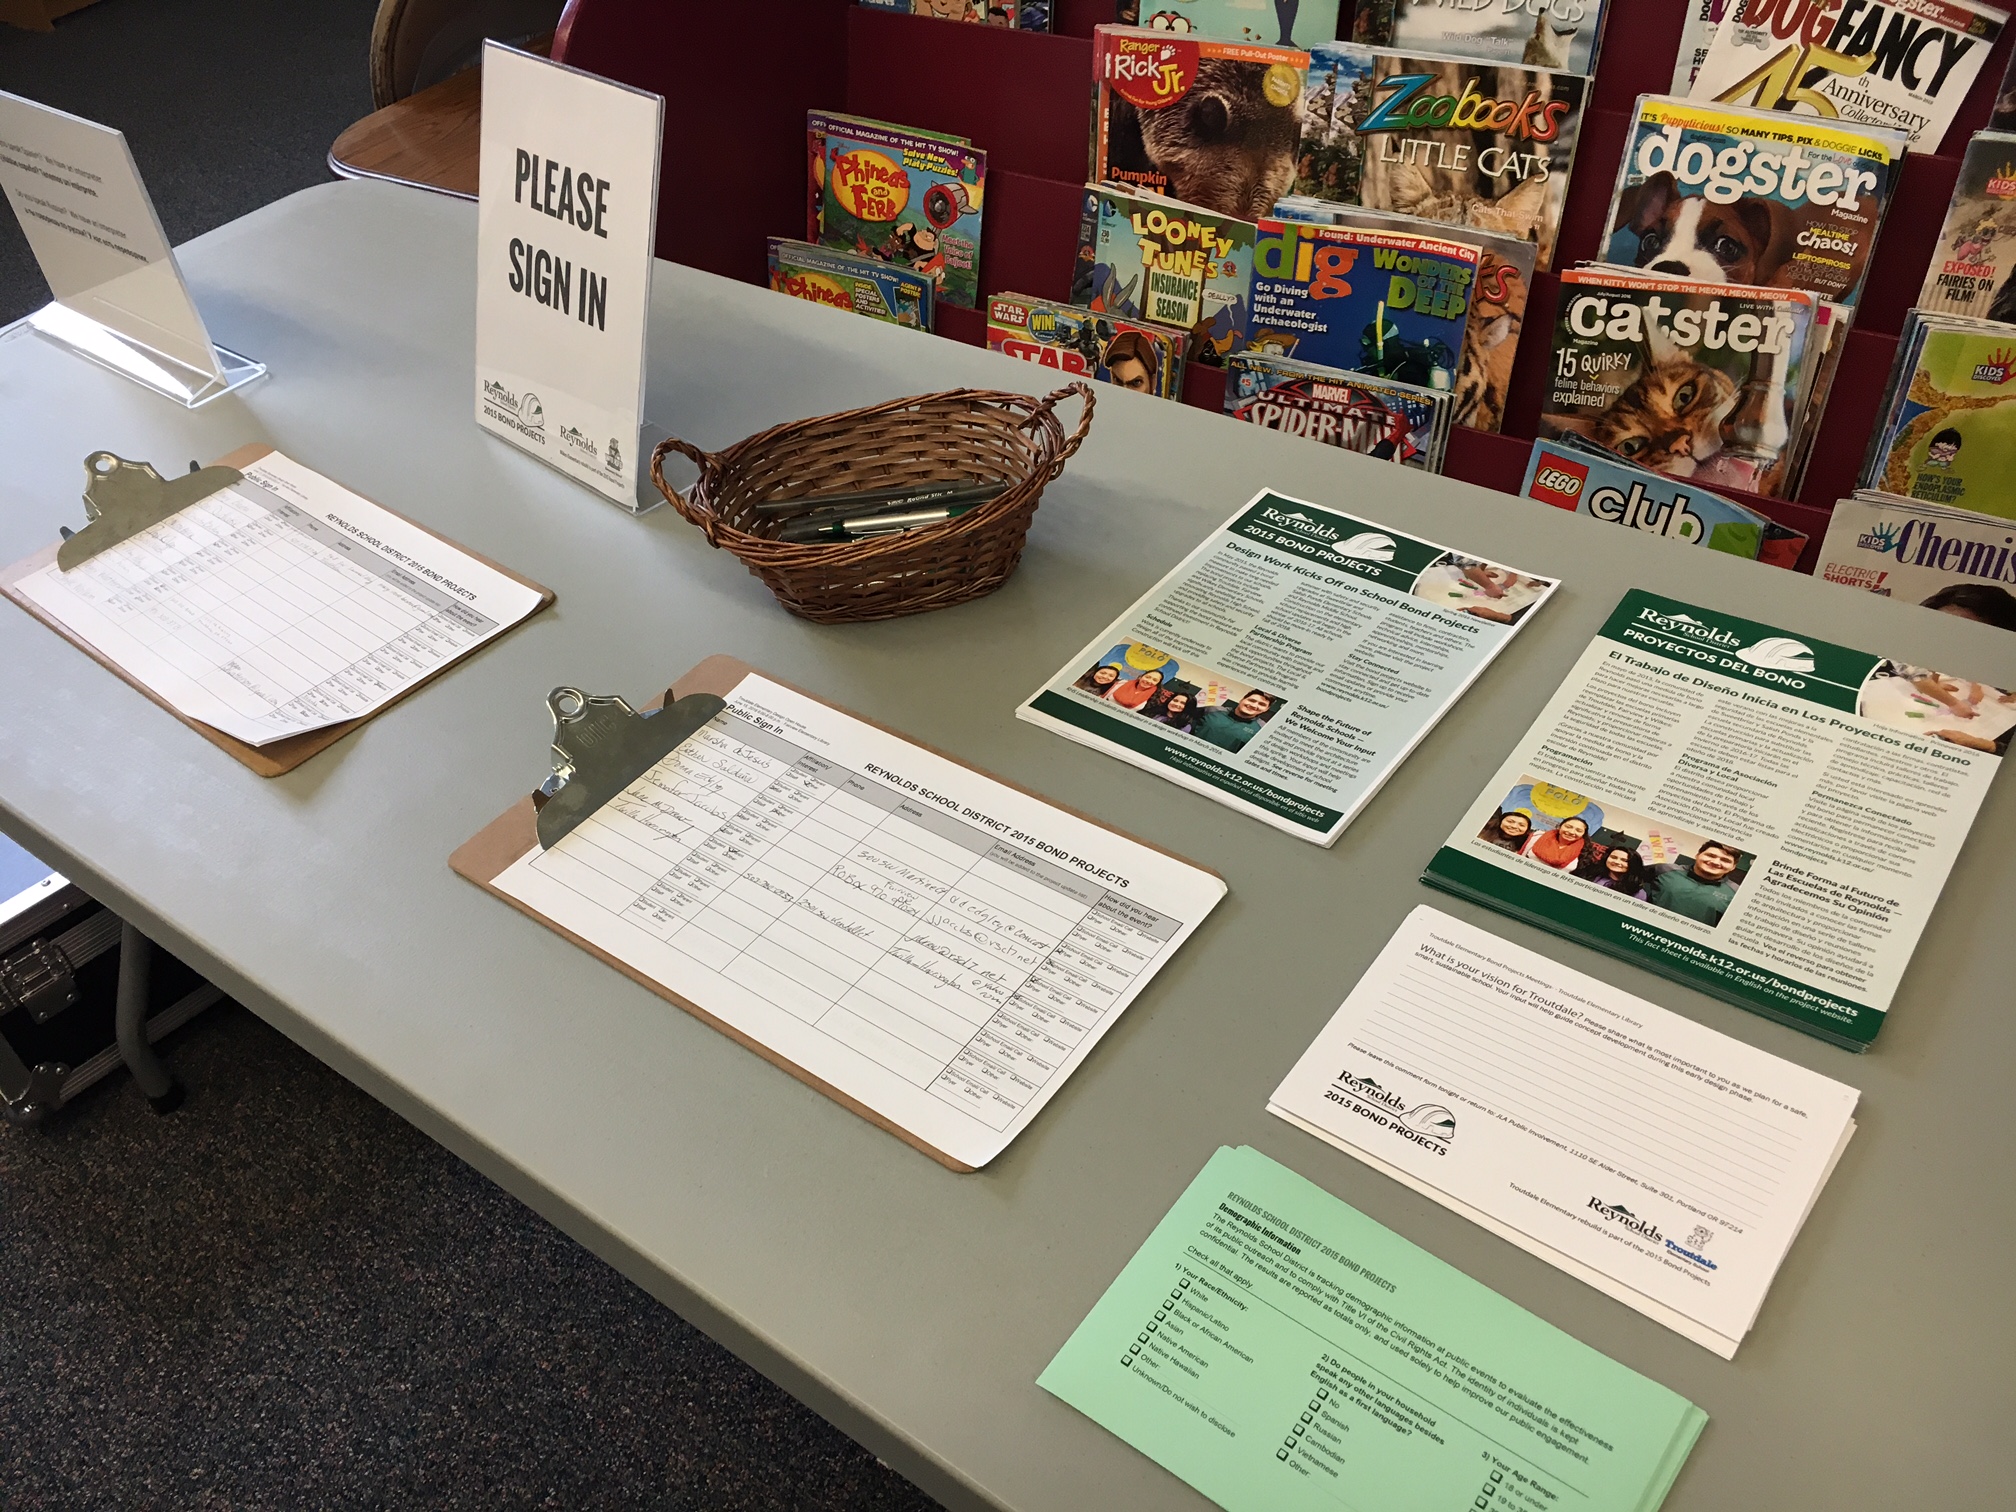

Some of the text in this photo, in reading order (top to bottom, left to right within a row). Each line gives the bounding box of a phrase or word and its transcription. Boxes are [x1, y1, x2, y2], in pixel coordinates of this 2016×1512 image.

[1120, 39, 1160, 54] Ranger
[1825, 0, 1977, 97] FANCY
[1115, 53, 1160, 81] Rick
[1153, 63, 1185, 95] Jr.
[1356, 74, 1570, 141] Zoobooks
[1821, 77, 1931, 132] Anniversary
[1641, 113, 1657, 122] IT'S
[1660, 113, 1725, 133] Puppylicious!
[1726, 126, 1739, 134] SO
[1741, 128, 1770, 139] MANY
[1772, 133, 1794, 144] TIPS,
[1797, 136, 1812, 145] PIX
[1822, 140, 1856, 153] DOGGIE
[1858, 148, 1882, 161] LICKS
[830, 148, 910, 188] Phineas
[903, 149, 945, 163] Solve New
[1380, 135, 1551, 182] LITTLE CATS
[1639, 126, 1877, 211] dogster
[514, 147, 611, 239] PLEASE
[851, 185, 897, 221] FERB
[873, 188, 888, 196] and
[1831, 209, 1868, 223] Magazine
[1131, 210, 1233, 258] LOONEY
[1319, 230, 1474, 261] Found: Underwater Ancient City
[1797, 231, 1858, 256] Chaos!
[1810, 227, 1849, 240] MEALTIME
[1138, 238, 1218, 279] TUNES
[1253, 221, 1359, 300] dig
[1374, 248, 1472, 283] WONDERS
[1792, 252, 1850, 269] LEPTOSPIROSIS
[1943, 261, 1996, 278] EXPOSED!
[508, 237, 607, 332] SIGN IN
[1151, 272, 1198, 300] INSURANCE
[1256, 282, 1308, 298] Go Diving
[1387, 275, 1466, 319] DEEP
[1418, 276, 1463, 296] OF THE
[1578, 276, 1601, 284] WHEN
[1604, 279, 1626, 288] KITTY
[1628, 281, 1655, 290] WON'T
[1658, 283, 1679, 292] STOP
[1681, 285, 1697, 293] THE
[1699, 287, 1727, 296] MEOW,
[1730, 290, 1758, 299] MEOW,
[1937, 274, 1994, 291] FAIRIES ON
[1945, 288, 1975, 302] FILM!
[994, 303, 1024, 315] STAR
[1156, 300, 1188, 322] SEASON
[1253, 304, 1316, 319] Underwater
[1255, 293, 1294, 305] with an
[994, 311, 1025, 323] WARS
[1032, 314, 1055, 331] WIN!
[1252, 314, 1327, 332] Archaeologist
[1556, 348, 1578, 378] 15
[1975, 366, 2004, 377] KIDS
[484, 379, 519, 409] Reynolds
[1231, 361, 1246, 370] ALL
[1277, 370, 1304, 379] FROM
[1307, 374, 1325, 383] THE
[1329, 378, 1344, 386] HIT
[1348, 381, 1396, 396] ANIMATED
[1400, 392, 1433, 406] SERIES!
[1313, 384, 1349, 402] MARVEL
[1553, 390, 1604, 407] explained
[1555, 377, 1620, 394] feline behaviors
[1258, 391, 1395, 426] ULTIMATE
[483, 405, 546, 445] 2015 BOND PROJECTS
[560, 425, 598, 456] Reynolds
[1538, 468, 1581, 495] LEGO
[1261, 507, 1340, 540] Reynolds
[1589, 481, 1704, 544] club
[1243, 525, 1382, 576] 2015 BOND PROJECTS
[1859, 535, 1886, 545] KIDS
[1825, 563, 1878, 579] ELECTRIC
[1225, 541, 1480, 634] Design Work Kicks Off on School Bond Projects
[1637, 607, 1741, 648] Reynolds
[1623, 629, 1806, 689] PROYECTOS DEL BONO
[726, 703, 784, 735] Public Sign In
[1609, 650, 1972, 766] El Trabajo de Diseño Inicia en Los Proyectos del Bono
[1164, 745, 1325, 818] www.reynolds.k12.or.us/bondprojects
[864, 762, 1130, 888] REYNOLDS SCHOOL DISTRICT 2015 BOND PROJECTS
[1420, 943, 1584, 1020] What is your vision for Troutdale?
[1621, 921, 1859, 1017] www.reynolds.k12.or.us/bondprojects
[1337, 1070, 1406, 1117] Reynolds
[1323, 1090, 1448, 1156] 2015 BOND PROJECTS
[1218, 1202, 1302, 1255] Demographic Information
[1587, 1196, 1663, 1242] Reynolds
[1227, 1191, 1397, 1294] REYNOLDS SCHOOL DISTRICT 2015 BOND PROJECTS
[1665, 1239, 1718, 1270] Troutdale
